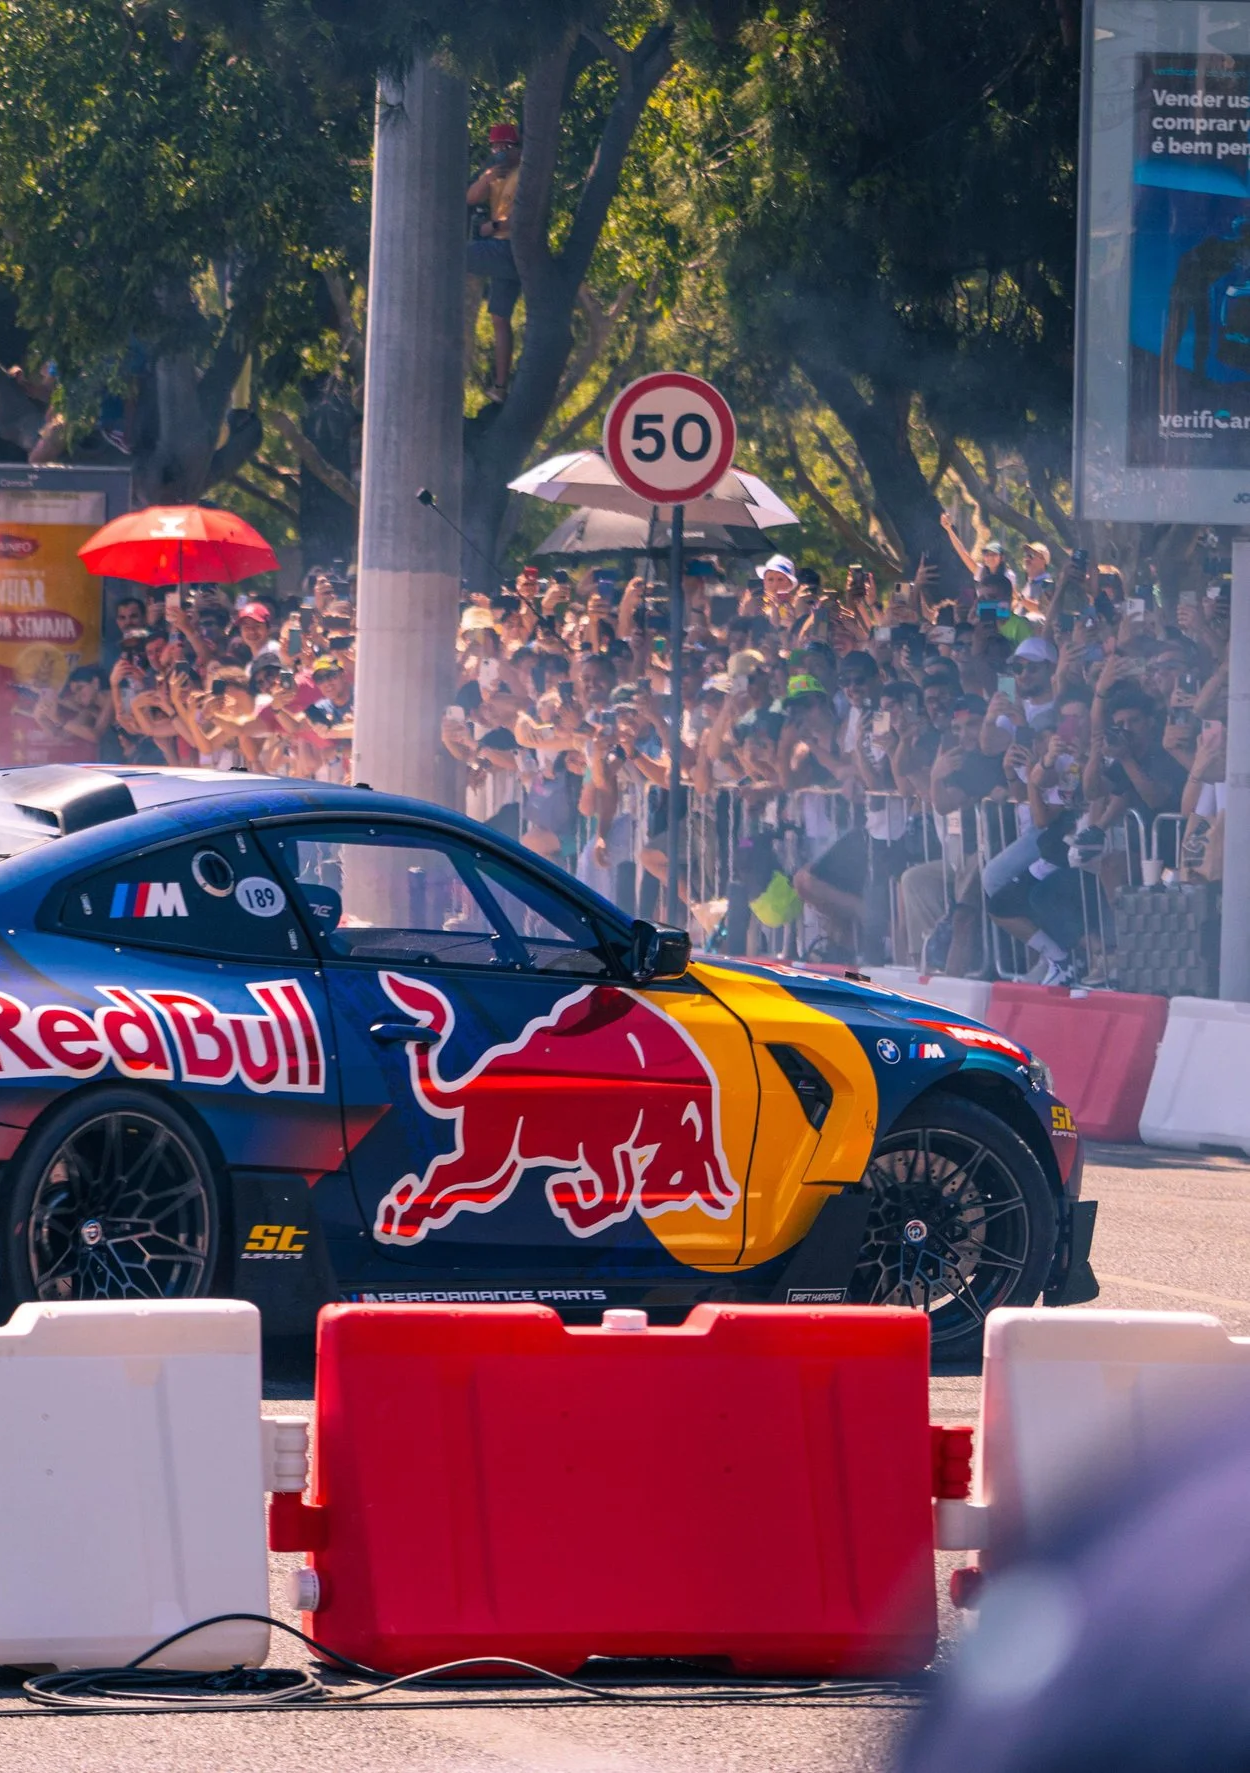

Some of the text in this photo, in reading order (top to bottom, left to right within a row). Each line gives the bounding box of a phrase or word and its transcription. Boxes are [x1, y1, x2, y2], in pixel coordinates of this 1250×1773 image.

[1152, 89, 1250, 109] Vender us
[1152, 117, 1236, 135] comprar
[1152, 137, 1164, 153] é
[1168, 137, 1212, 155] bem
[631, 412, 712, 463] 50
[16, 616, 78, 638] SEMANA
[245, 887, 275, 908] 189
[378, 1290, 536, 1302] PERFORMANCE
[537, 1289, 607, 1300] PARTS
[791, 1292, 842, 1302] DRIFT HAPPENS
